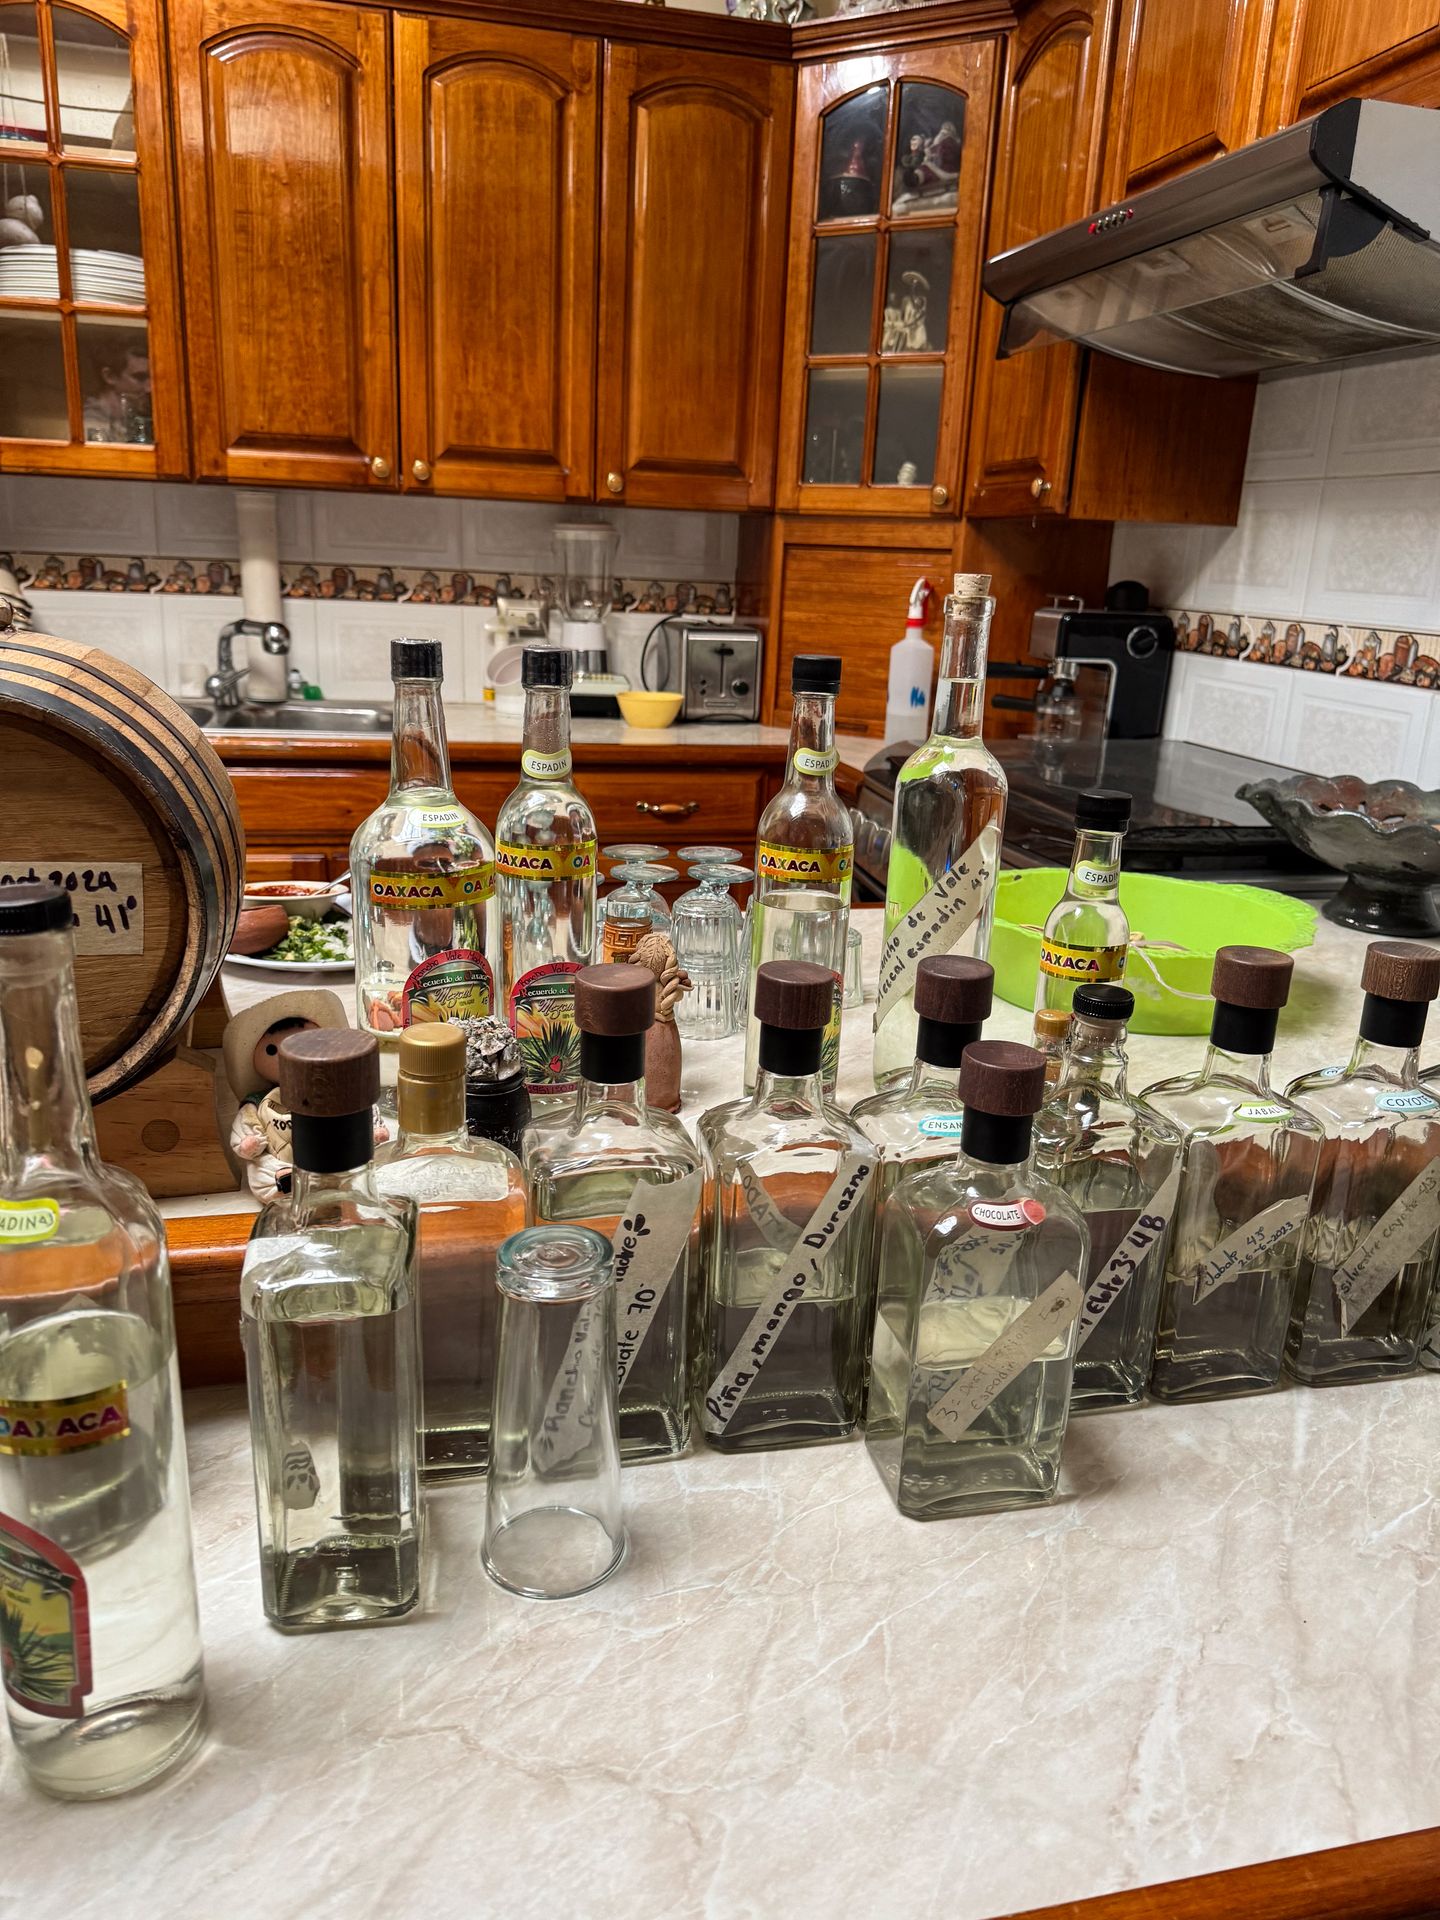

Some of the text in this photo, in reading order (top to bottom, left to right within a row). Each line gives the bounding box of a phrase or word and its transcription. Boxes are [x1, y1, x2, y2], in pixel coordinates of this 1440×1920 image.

[531, 760, 567, 772] ESPADIN
[804, 758, 834, 769] ESPAD
[422, 813, 460, 822] ESPADIN
[497, 851, 553, 870] OAXACA
[761, 853, 821, 873] OAXACA
[373, 883, 444, 898] OAXACA
[879, 936, 900, 974] ancho
[907, 911, 926, 928] de
[934, 862, 970, 898] Vale
[1041, 948, 1100, 972] OAXACA
[414, 976, 453, 990] Recuerdo
[520, 987, 557, 998] Recuerdo
[802, 1164, 870, 1250] Durazno
[974, 1206, 1021, 1220] CHOCOLATE
